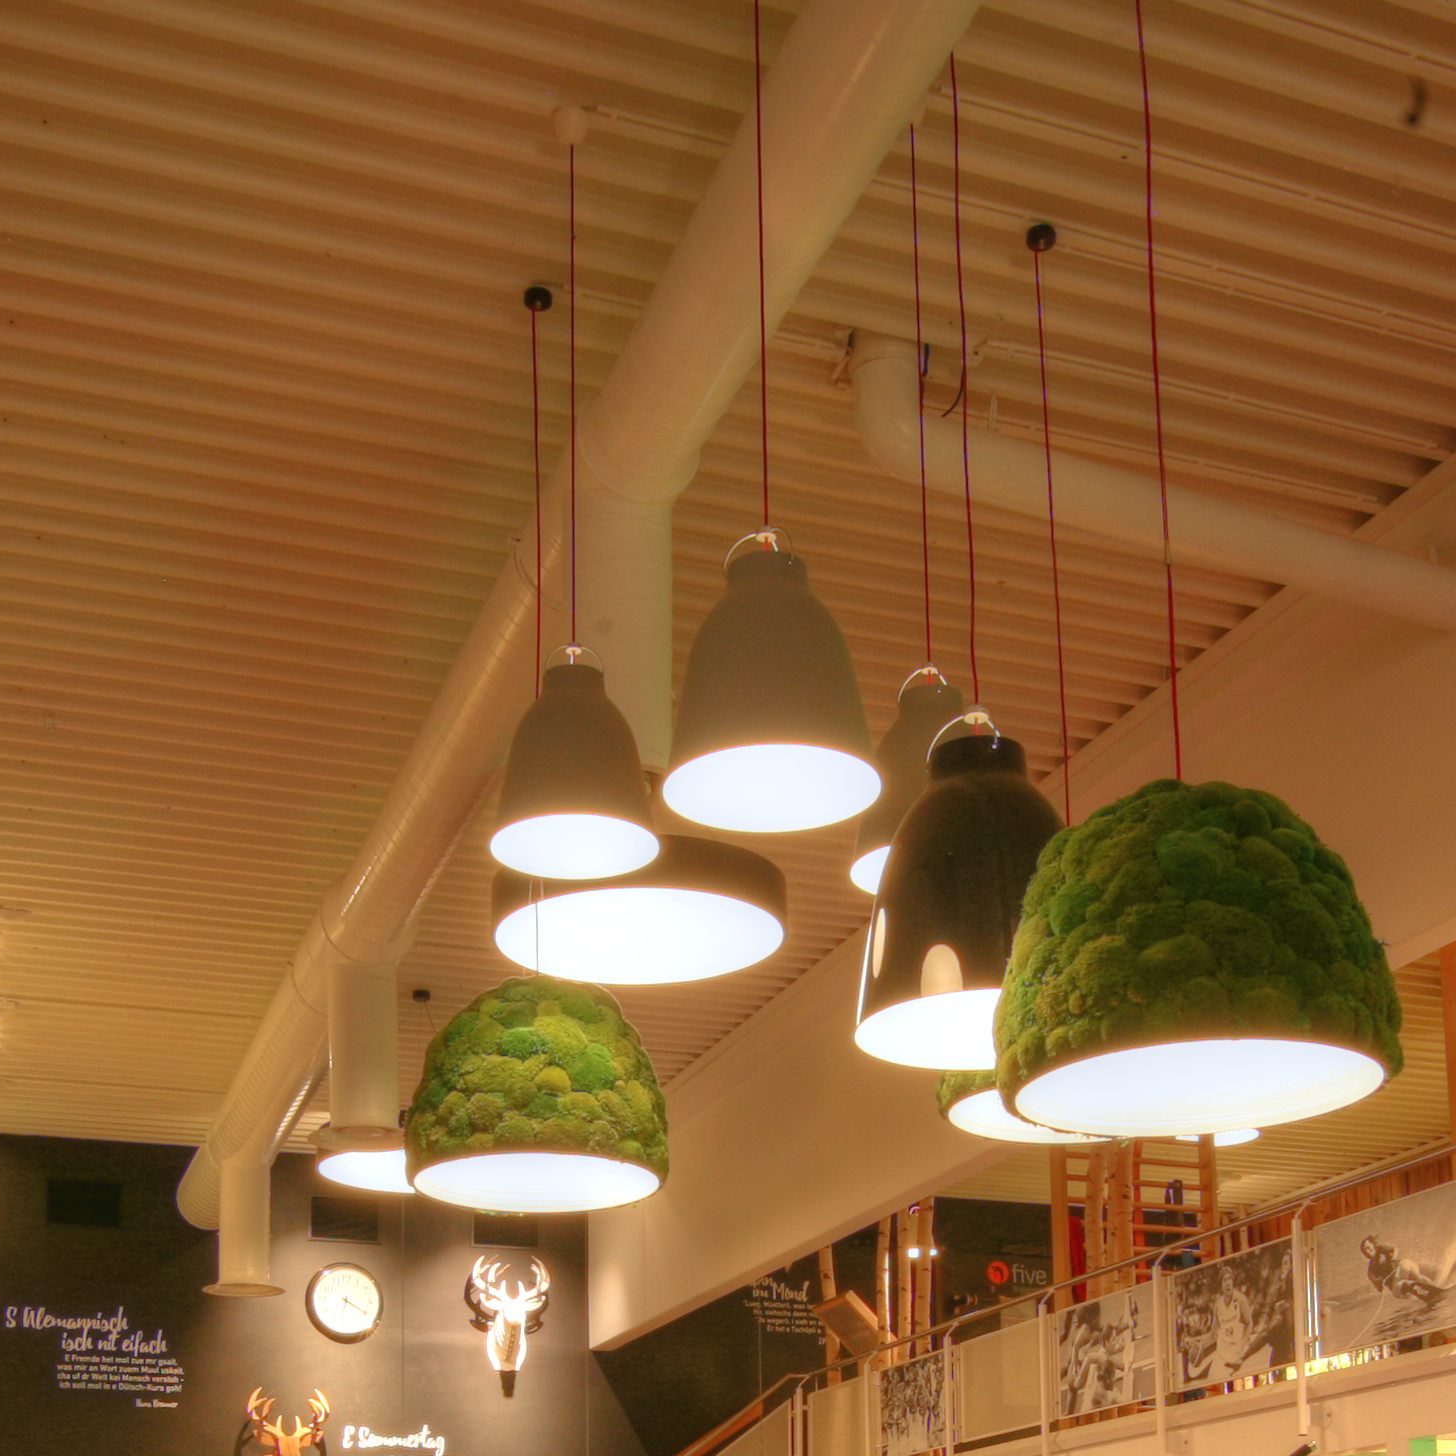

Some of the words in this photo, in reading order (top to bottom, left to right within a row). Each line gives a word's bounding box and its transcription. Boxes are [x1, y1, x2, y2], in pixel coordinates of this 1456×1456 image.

[1011, 1263, 1048, 1286] five
[772, 1281, 810, 1302] Mond
[5, 1305, 18, 1328] S
[22, 1305, 129, 1332] Alemannisch
[61, 1329, 93, 1352] isch
[98, 1331, 120, 1352] nit
[121, 1329, 168, 1357] eifach
[342, 1424, 356, 1449] E
